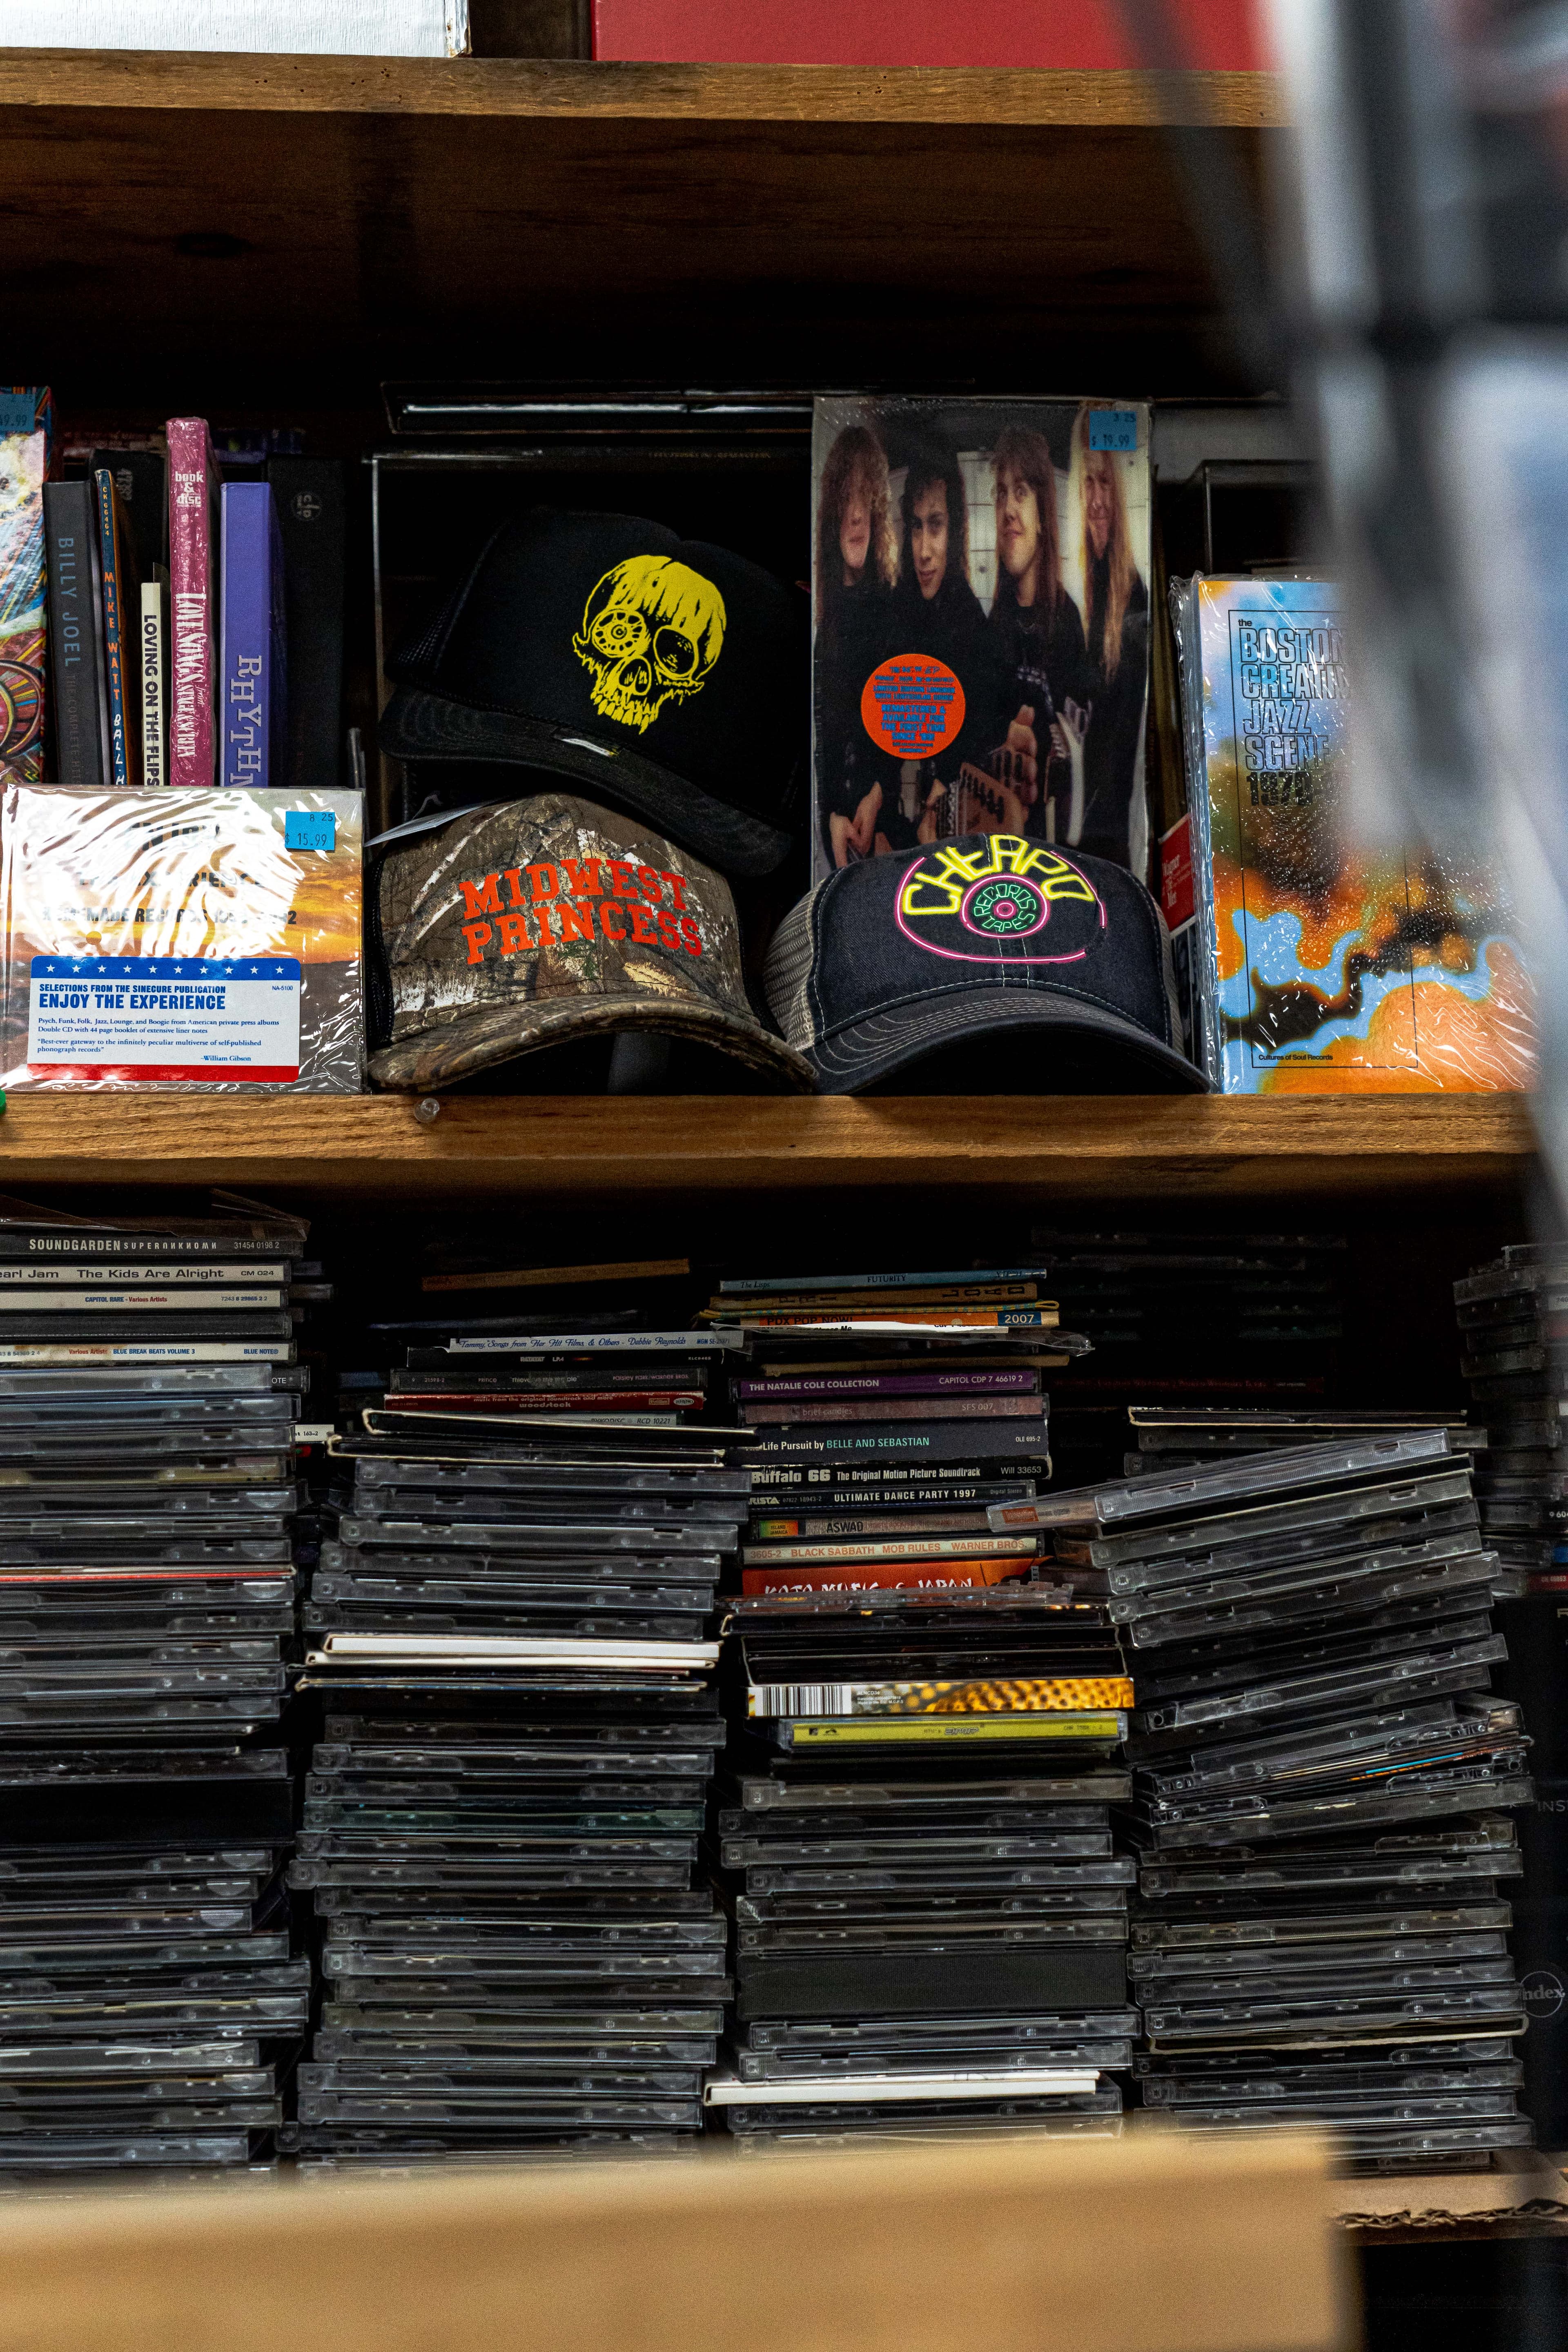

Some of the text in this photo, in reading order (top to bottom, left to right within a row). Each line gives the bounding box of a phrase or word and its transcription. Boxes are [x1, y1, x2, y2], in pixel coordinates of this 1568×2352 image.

[175, 470, 204, 483] book
[184, 481, 195, 493] &
[177, 493, 202, 505] disc
[58, 537, 81, 667] BILLY JOEL
[1238, 619, 1252, 627] the
[105, 572, 120, 701] MIKE WATT
[144, 614, 160, 741] LOVING ON THE
[881, 704, 937, 713] REMASTERED
[882, 713, 926, 722] AVAILABLE
[1243, 699, 1312, 735] JAZZ
[881, 722, 896, 731] THE
[321, 813, 333, 822] 25
[285, 832, 327, 846] $ 15.99
[902, 835, 1096, 915] CHEAPO
[459, 858, 687, 920] MIDWEST
[973, 883, 1038, 917] RECORDS
[981, 910, 1037, 933] TAPES
[461, 901, 702, 965] PRINCESS
[39, 984, 226, 993] SELECTIONS FROM THE SINECURE PUBLICATION
[39, 993, 225, 1010] ENJOY THE EXPERIENCE
[70, 1040, 96, 1048] gateway
[96, 1040, 104, 1048] to
[29, 1239, 120, 1250] SOUNDGARDEN
[28, 1268, 224, 1281] Jam The Kids Are Alright
[867, 1275, 906, 1283] FUTURITY
[1004, 1314, 1035, 1324] 2007
[511, 1340, 526, 1349] from
[628, 1337, 652, 1345] Debbie
[655, 1336, 686, 1346] Reynolds
[767, 1382, 801, 1390] NATALIE
[827, 1379, 879, 1388] COLLECTION
[939, 1376, 969, 1384] CAPITOL
[823, 1407, 853, 1415] candles
[762, 1437, 929, 1451] Life Pursuit by BELLE AND SEBASTIAN
[751, 1470, 802, 1484] Buffalo
[808, 1469, 831, 1482] 66
[836, 1471, 849, 1481] The
[852, 1470, 881, 1481] Original
[883, 1470, 907, 1480] Motion
[909, 1468, 937, 1479] Picture
[939, 1467, 981, 1478] Soundtrack
[1017, 1466, 1042, 1474] 33653
[834, 1489, 976, 1502] ULTIMATE DANCE PARTY 1997
[826, 1521, 864, 1533] ASWAD
[791, 1541, 993, 1557] BLACK SABBATH MOB RULES WARNER
